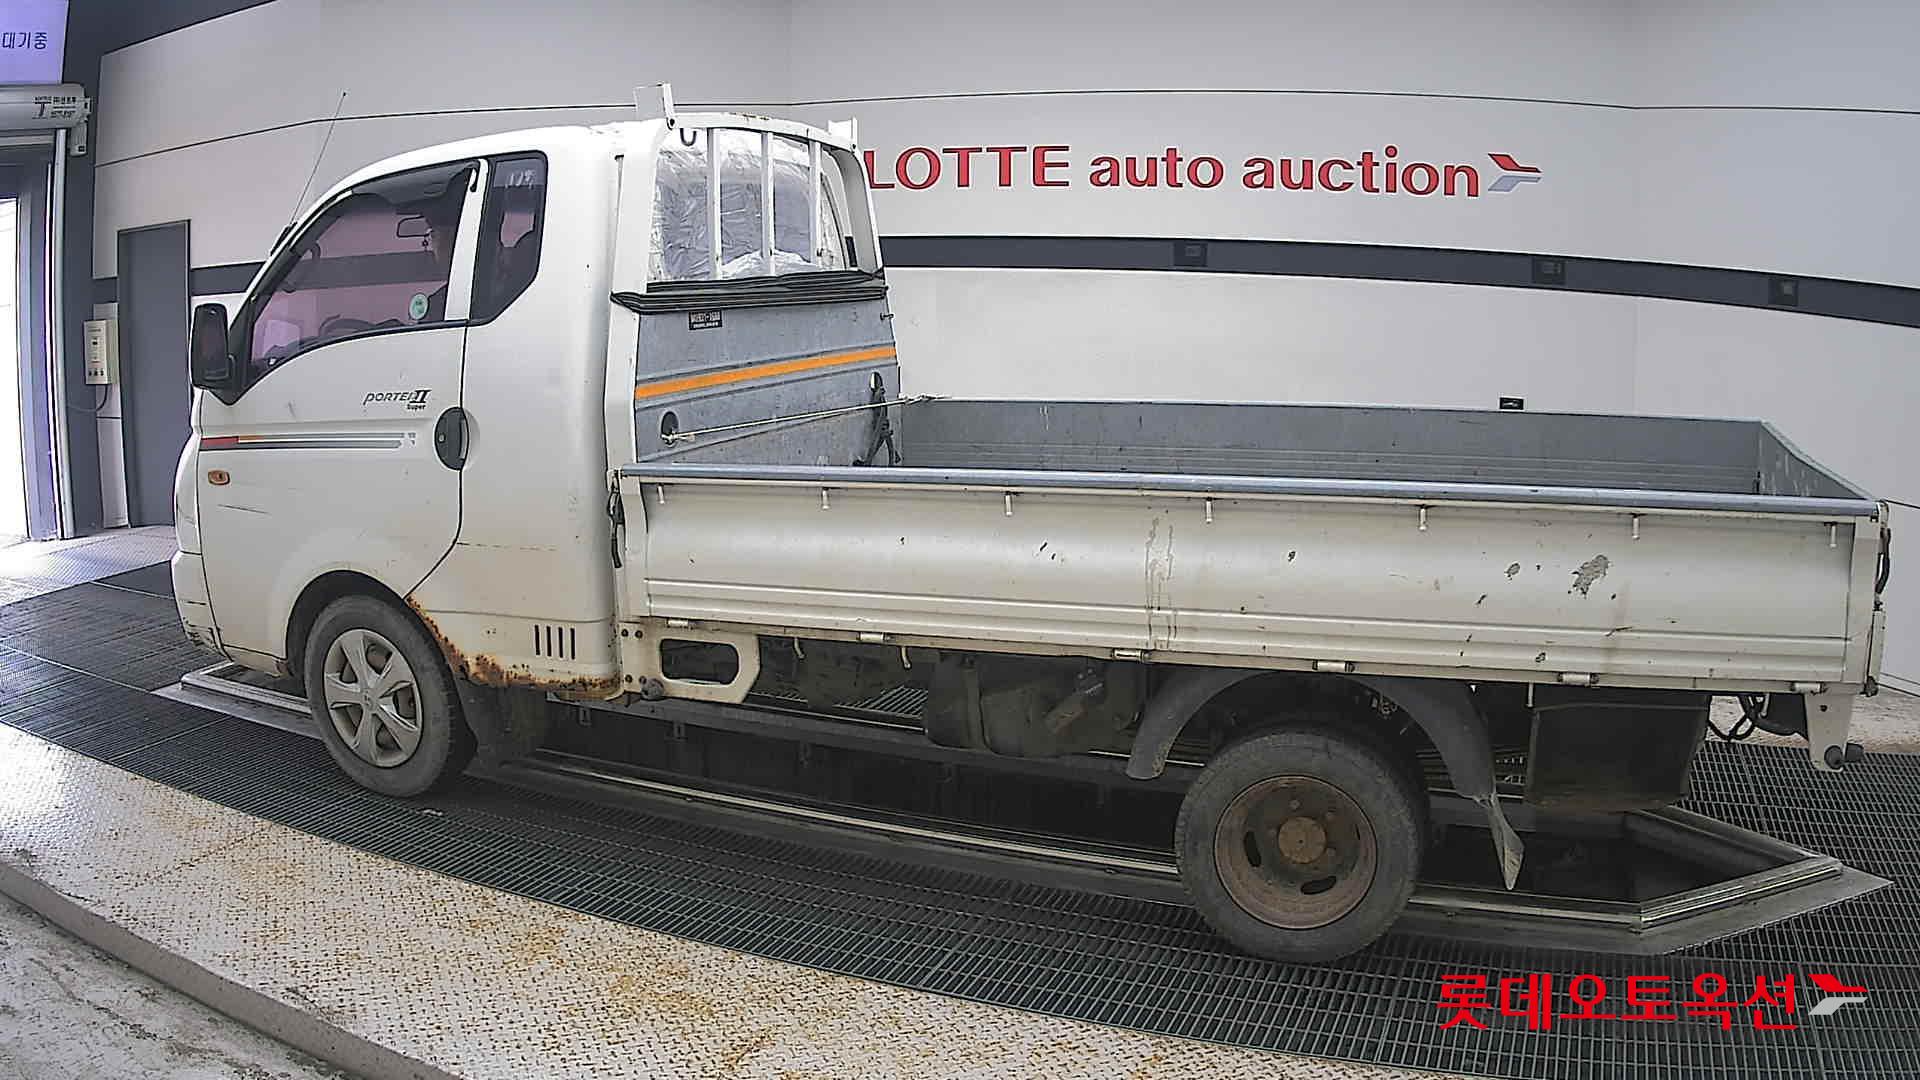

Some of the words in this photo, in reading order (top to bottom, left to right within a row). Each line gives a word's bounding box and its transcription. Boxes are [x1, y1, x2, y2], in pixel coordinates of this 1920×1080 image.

[2, 32, 48, 50] 대기중
[863, 145, 1070, 190] LOTTE
[1089, 147, 1224, 189] auto
[1241, 145, 1480, 198] auction
